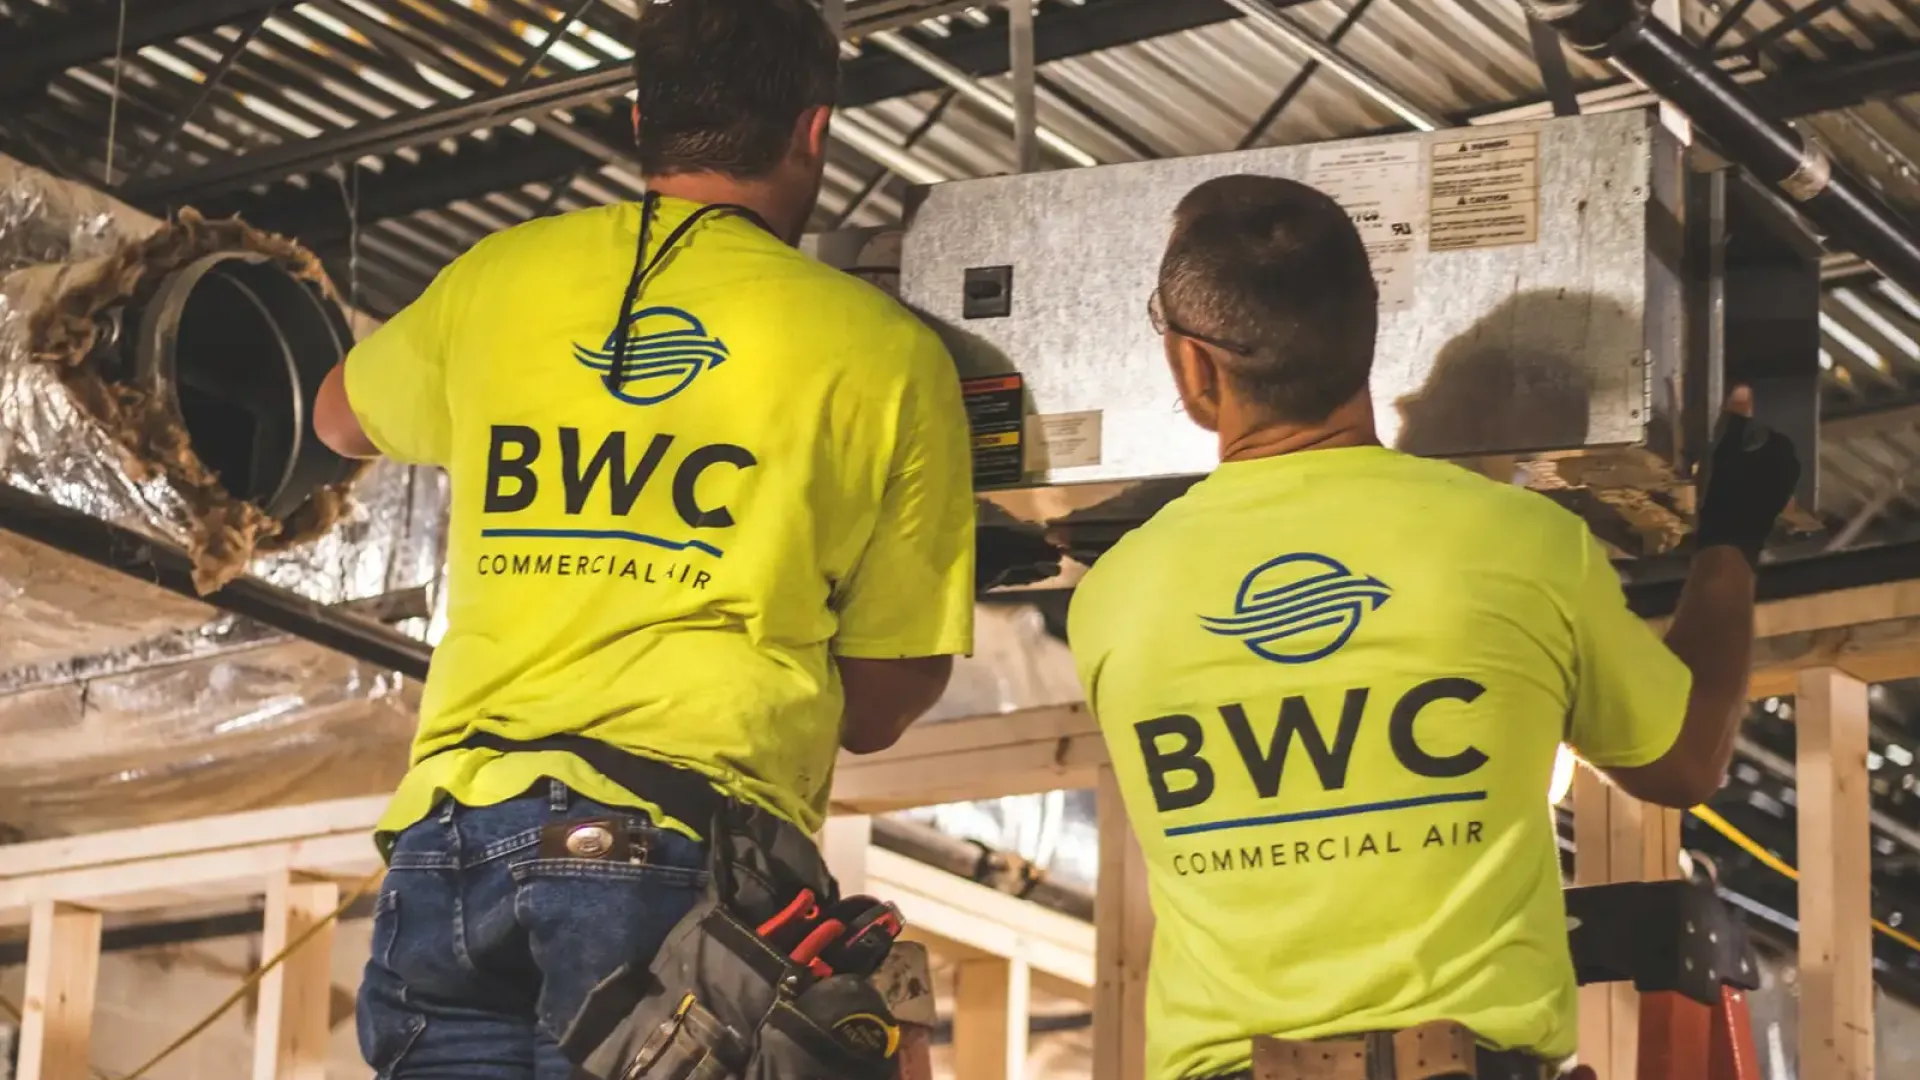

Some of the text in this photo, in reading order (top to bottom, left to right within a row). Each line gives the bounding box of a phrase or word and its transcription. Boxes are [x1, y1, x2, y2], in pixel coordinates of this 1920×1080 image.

[484, 425, 757, 529] BWC
[478, 554, 656, 584] COMMERCIAL
[1134, 678, 1490, 812] BWC
[1173, 820, 1485, 876] COMMERCIAL AIR
